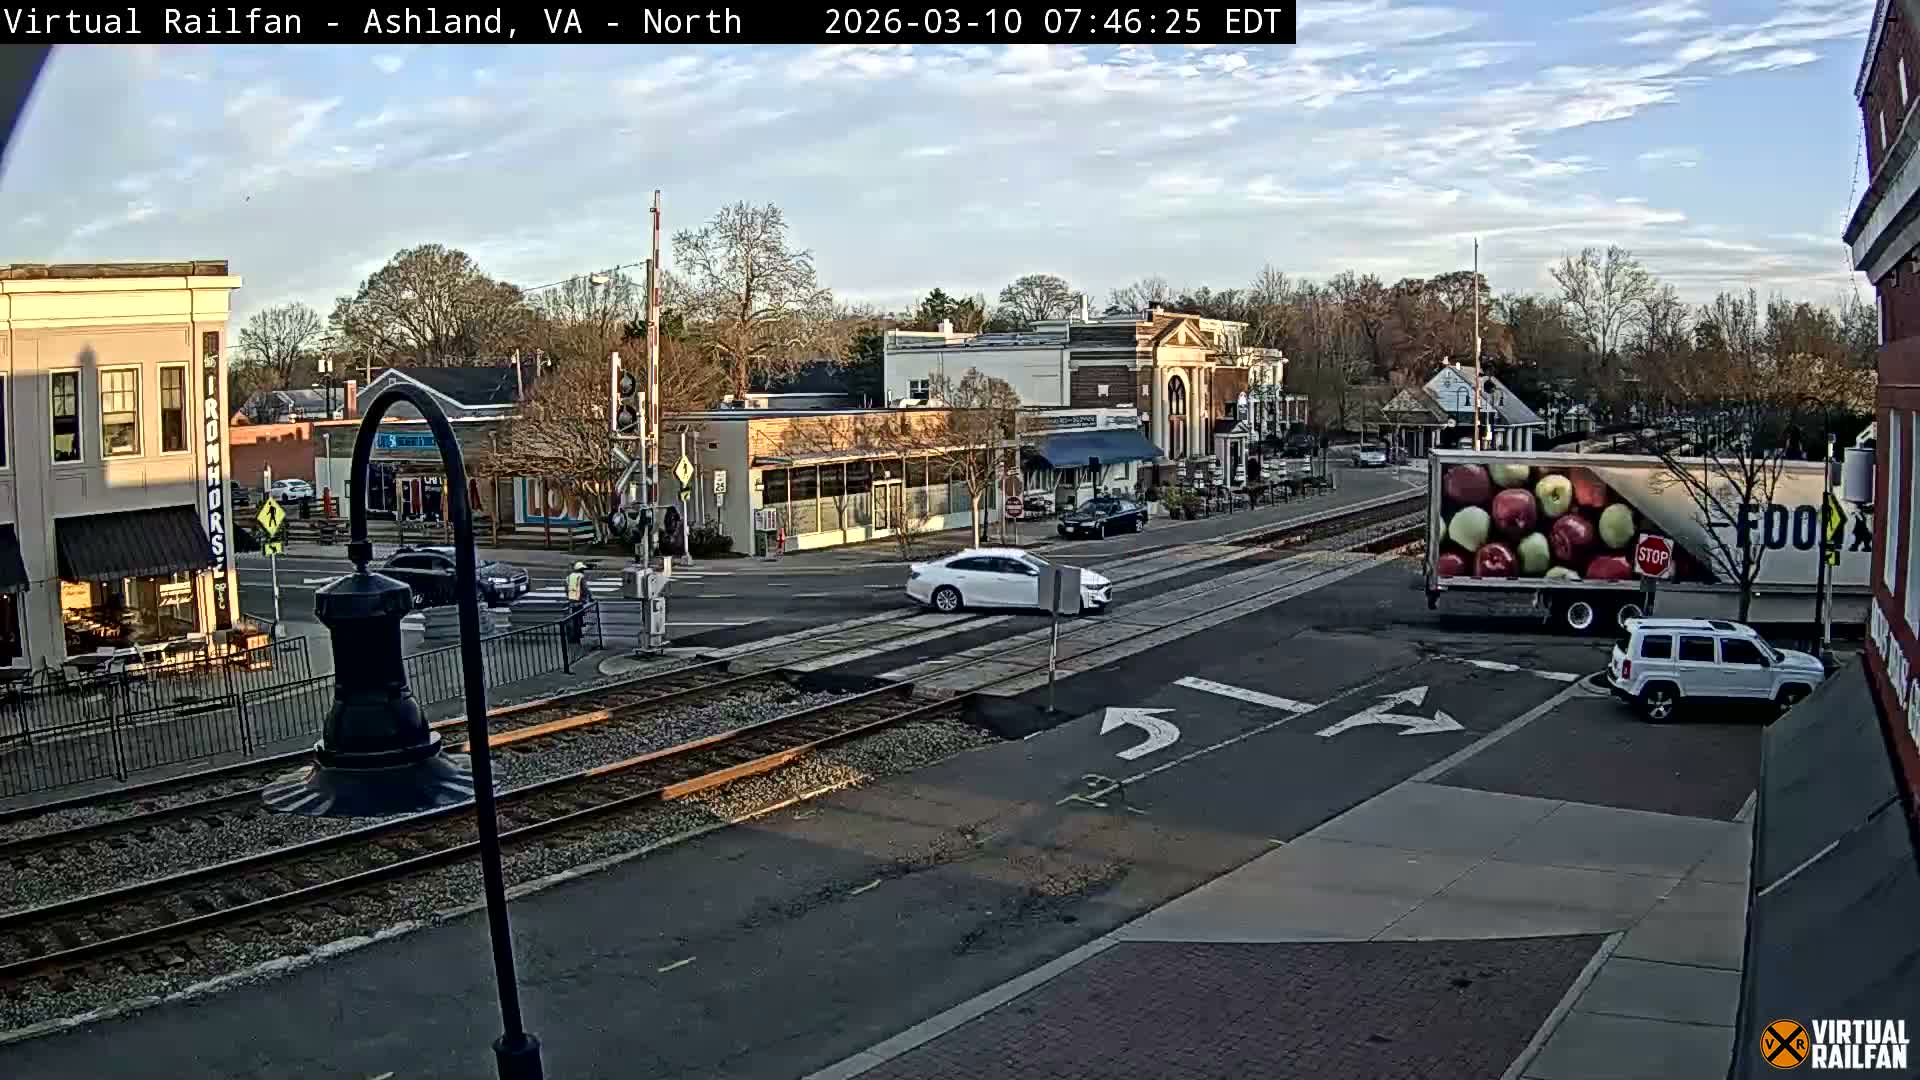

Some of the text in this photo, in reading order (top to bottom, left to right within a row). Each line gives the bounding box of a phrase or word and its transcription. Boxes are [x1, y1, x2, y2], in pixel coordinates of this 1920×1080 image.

[716, 482, 725, 491] 25
[1736, 503, 1844, 551] FOO
[1639, 547, 1668, 565] STOP
